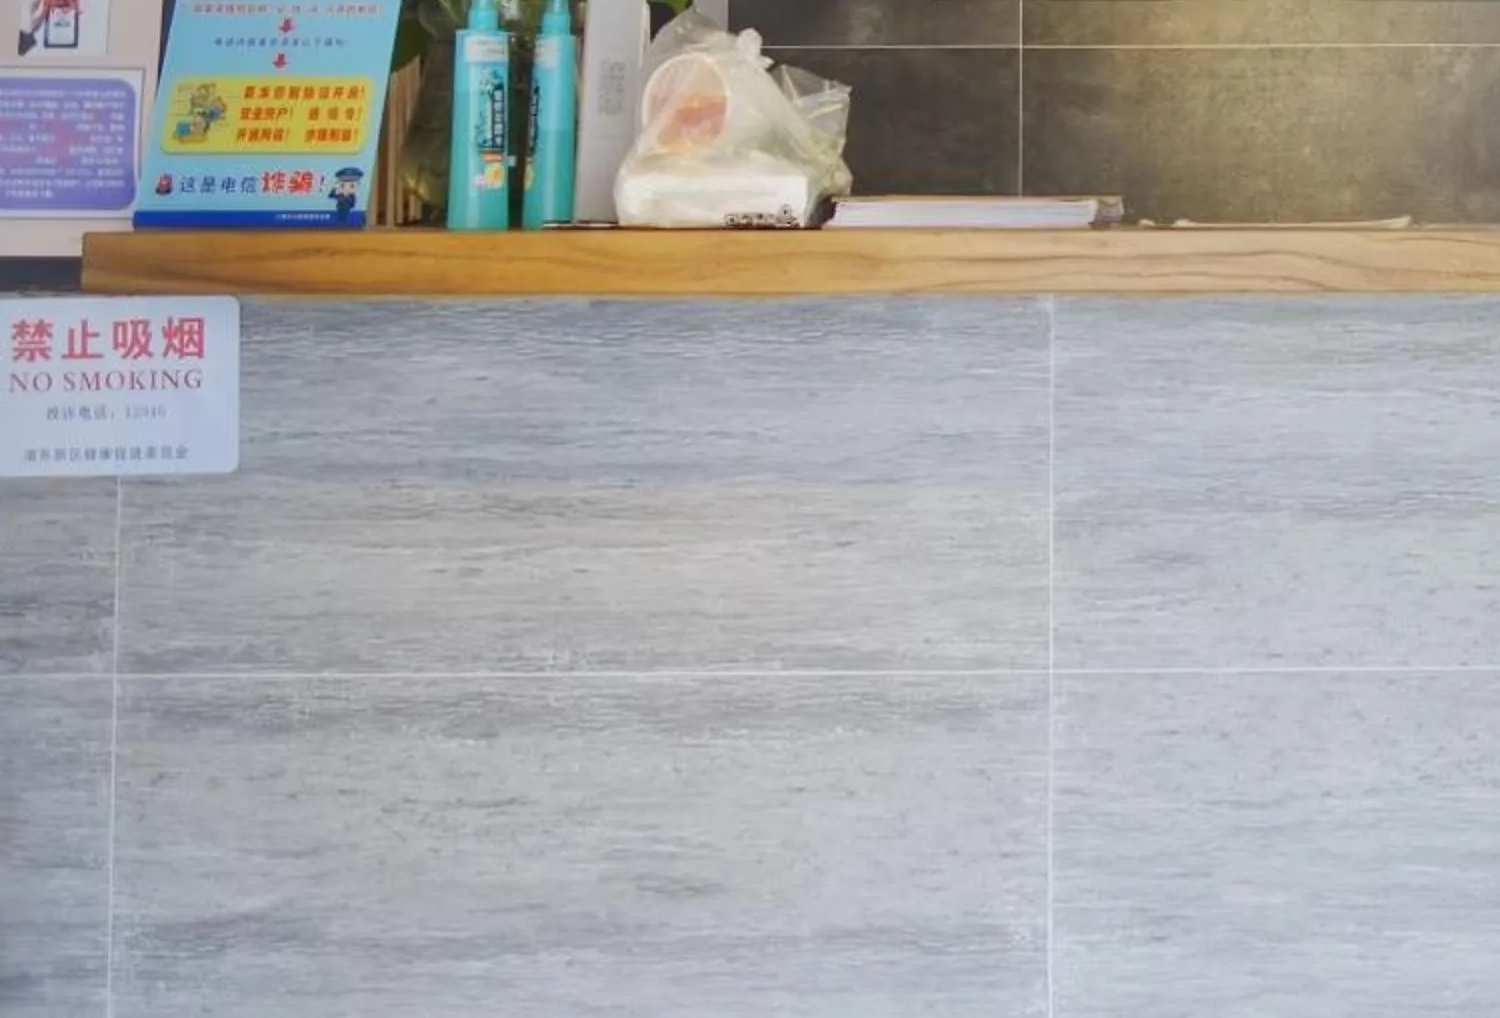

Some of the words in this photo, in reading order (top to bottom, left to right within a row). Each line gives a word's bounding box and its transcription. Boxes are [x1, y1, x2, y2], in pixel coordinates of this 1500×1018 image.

[11, 316, 206, 362] 禁止吸烟
[9, 371, 53, 393] NO
[62, 369, 203, 392] SMOKING
